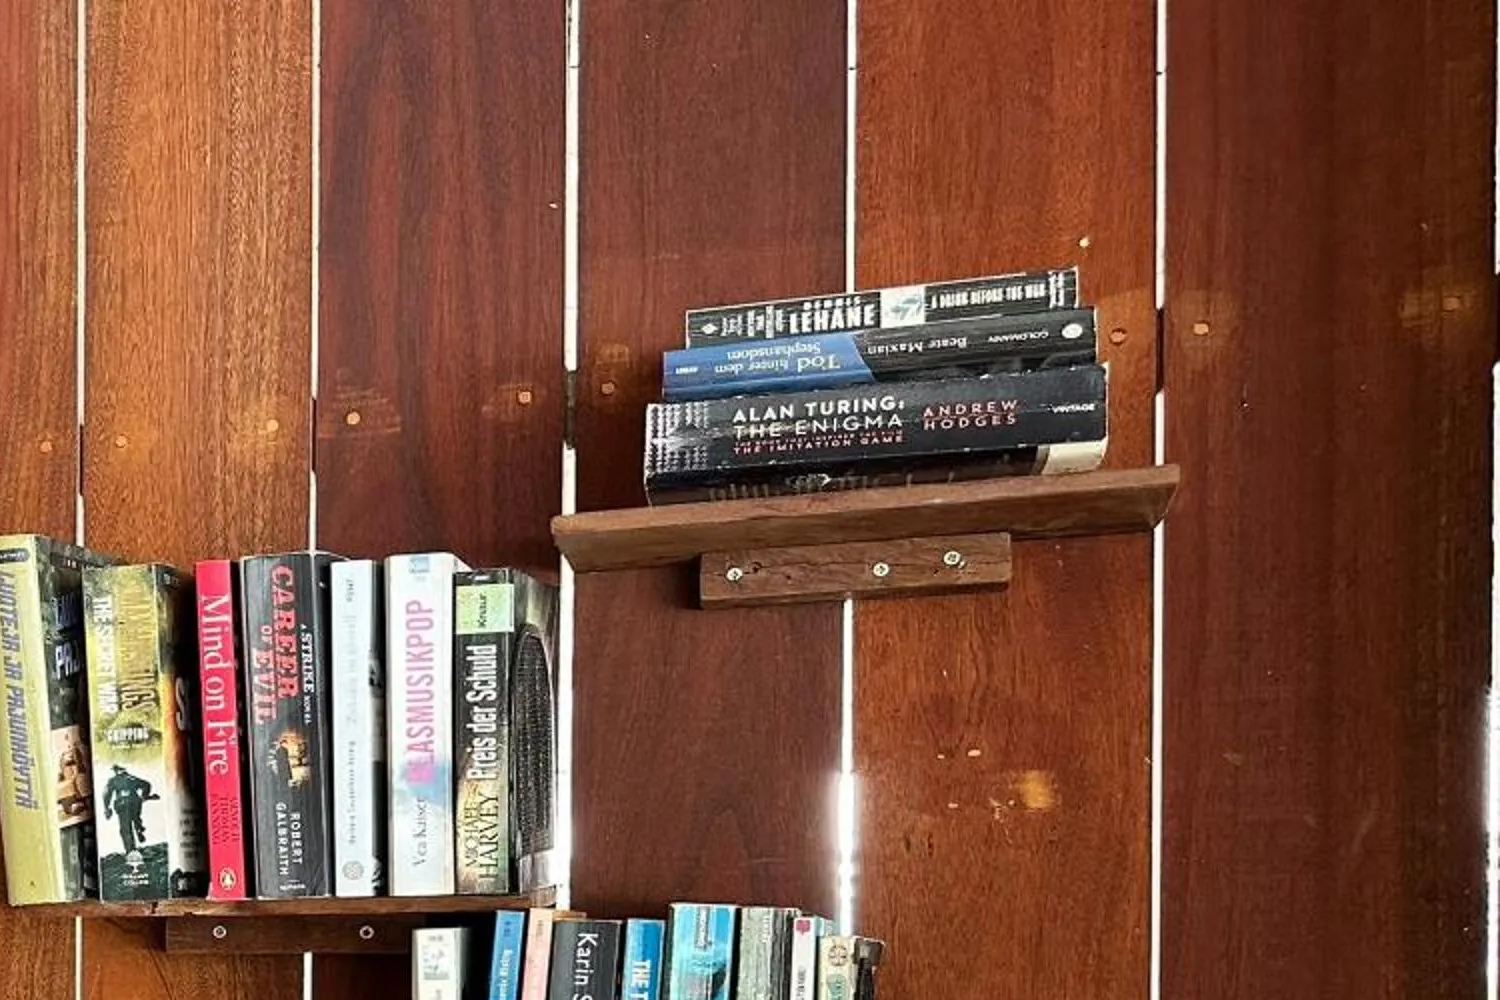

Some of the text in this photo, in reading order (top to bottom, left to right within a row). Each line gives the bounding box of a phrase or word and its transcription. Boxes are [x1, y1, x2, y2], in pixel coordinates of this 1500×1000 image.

[789, 303, 876, 335] LEHANE
[866, 330, 1049, 355] GOLDMANN Beate Maxian
[714, 363, 743, 376] dem
[747, 359, 790, 373] hinter
[797, 354, 840, 373] Tod
[732, 395, 906, 423] ALAN TURING:
[922, 399, 1019, 418] ANDREW
[732, 413, 904, 440] THE ENIGMA
[922, 414, 1018, 433] HODGES
[732, 434, 904, 455] THE IMITATION GAME
[92, 597, 113, 625] THE
[271, 564, 299, 700] CAREER
[4, 654, 23, 682] JA
[253, 624, 277, 726] OF EVIL
[301, 631, 314, 694] STRIKE
[201, 594, 239, 777] Mind on Fire
[465, 643, 498, 781] Preis der Schuld
[275, 801, 290, 877] GALBRAITH
[290, 810, 303, 866] ROBERT
[479, 792, 499, 880] HARVEY
[575, 931, 599, 987] Karin
[632, 959, 650, 989] THE
